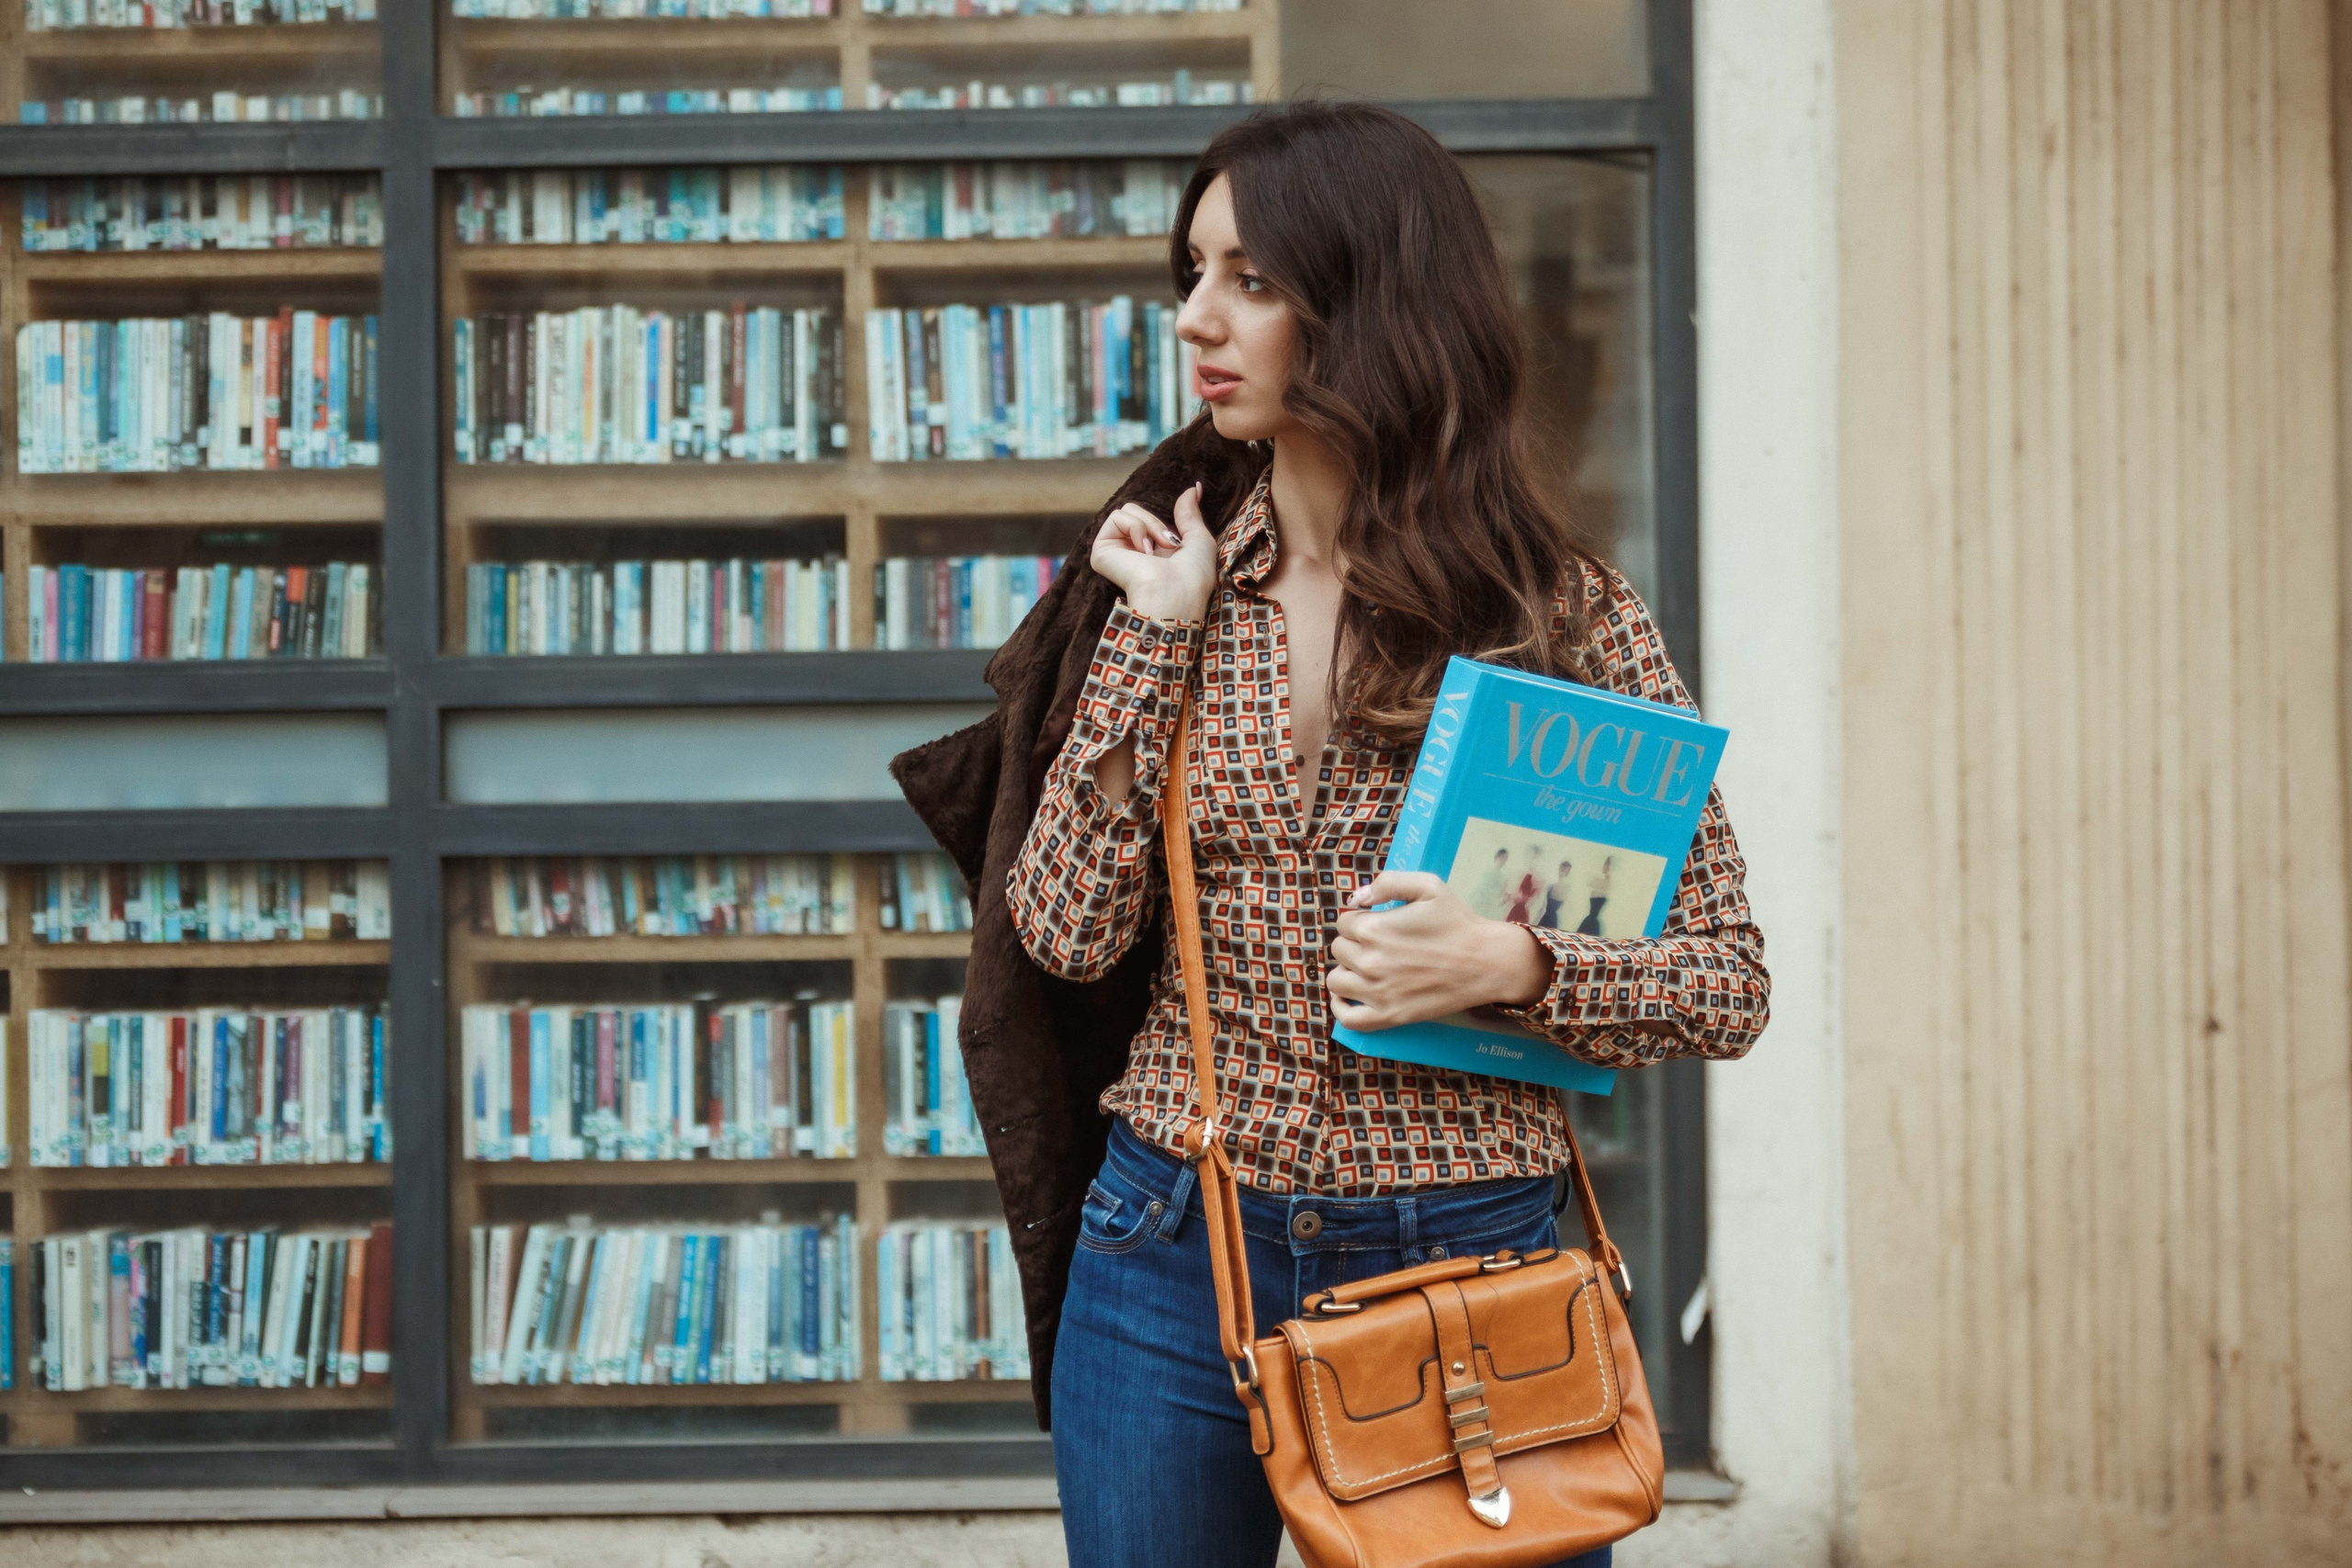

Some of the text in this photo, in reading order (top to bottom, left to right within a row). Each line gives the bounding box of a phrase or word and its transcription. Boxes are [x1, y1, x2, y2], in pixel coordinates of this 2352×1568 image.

[1405, 692, 1469, 858] VOGUE the
[1506, 701, 1705, 807] VOGUE
[1533, 784, 1622, 824] the gown
[1476, 1043, 1523, 1060] Jo Ellison
